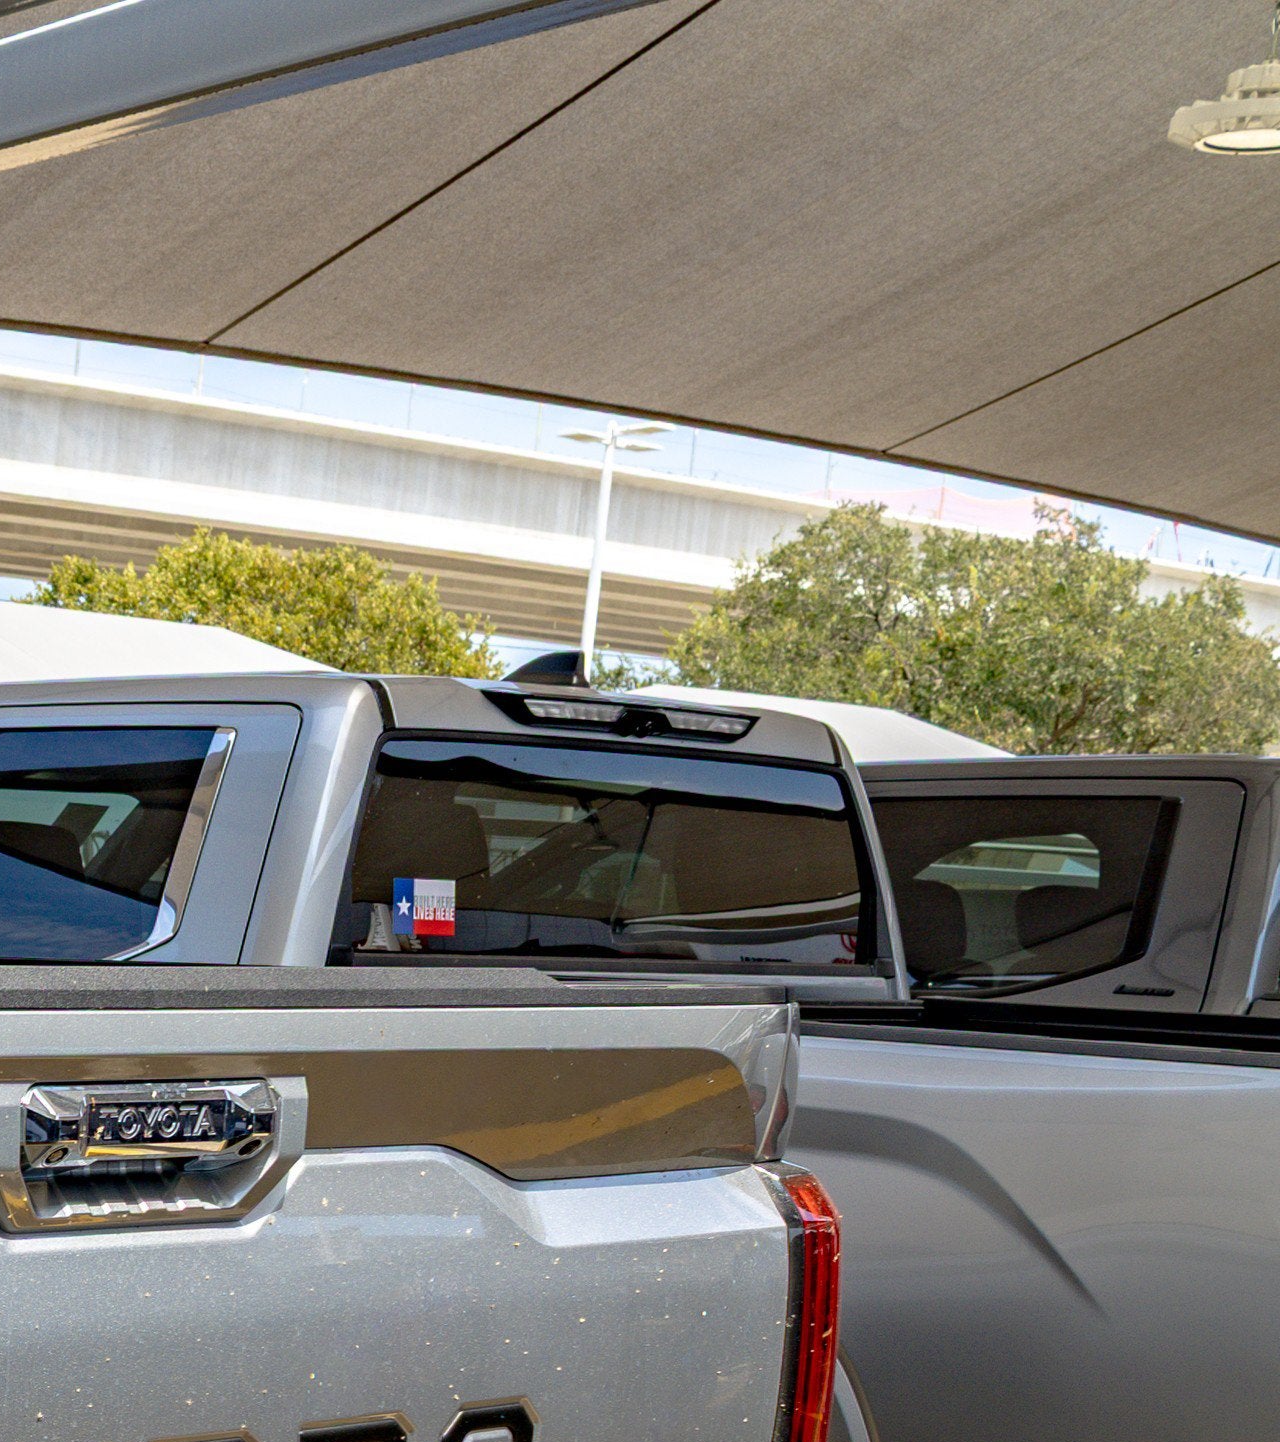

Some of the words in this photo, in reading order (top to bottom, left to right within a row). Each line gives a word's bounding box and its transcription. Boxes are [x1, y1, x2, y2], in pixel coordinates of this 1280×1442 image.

[413, 906, 435, 920] LIVES
[435, 907, 455, 921] HERE
[98, 1104, 217, 1142] TOYOTA
